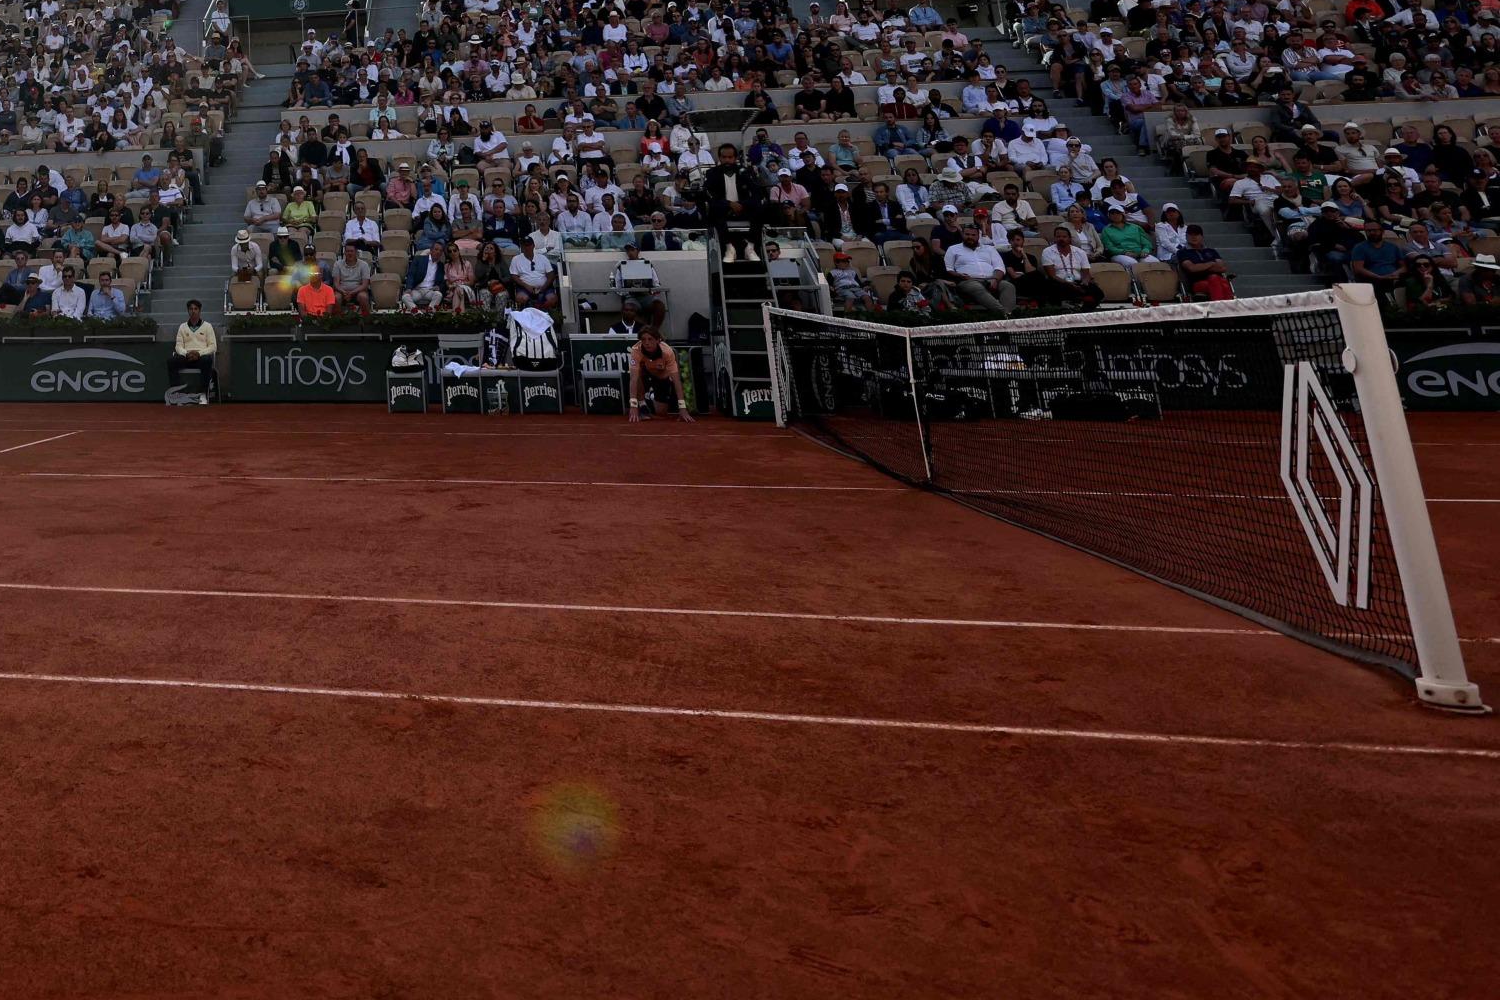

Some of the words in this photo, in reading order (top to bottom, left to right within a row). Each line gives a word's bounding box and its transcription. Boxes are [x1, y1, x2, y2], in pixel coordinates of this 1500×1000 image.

[256, 347, 367, 392] Infosys
[390, 382, 421, 405] perrier
[446, 382, 479, 407] perrier
[523, 382, 557, 407] perrier
[587, 384, 621, 408] perrier
